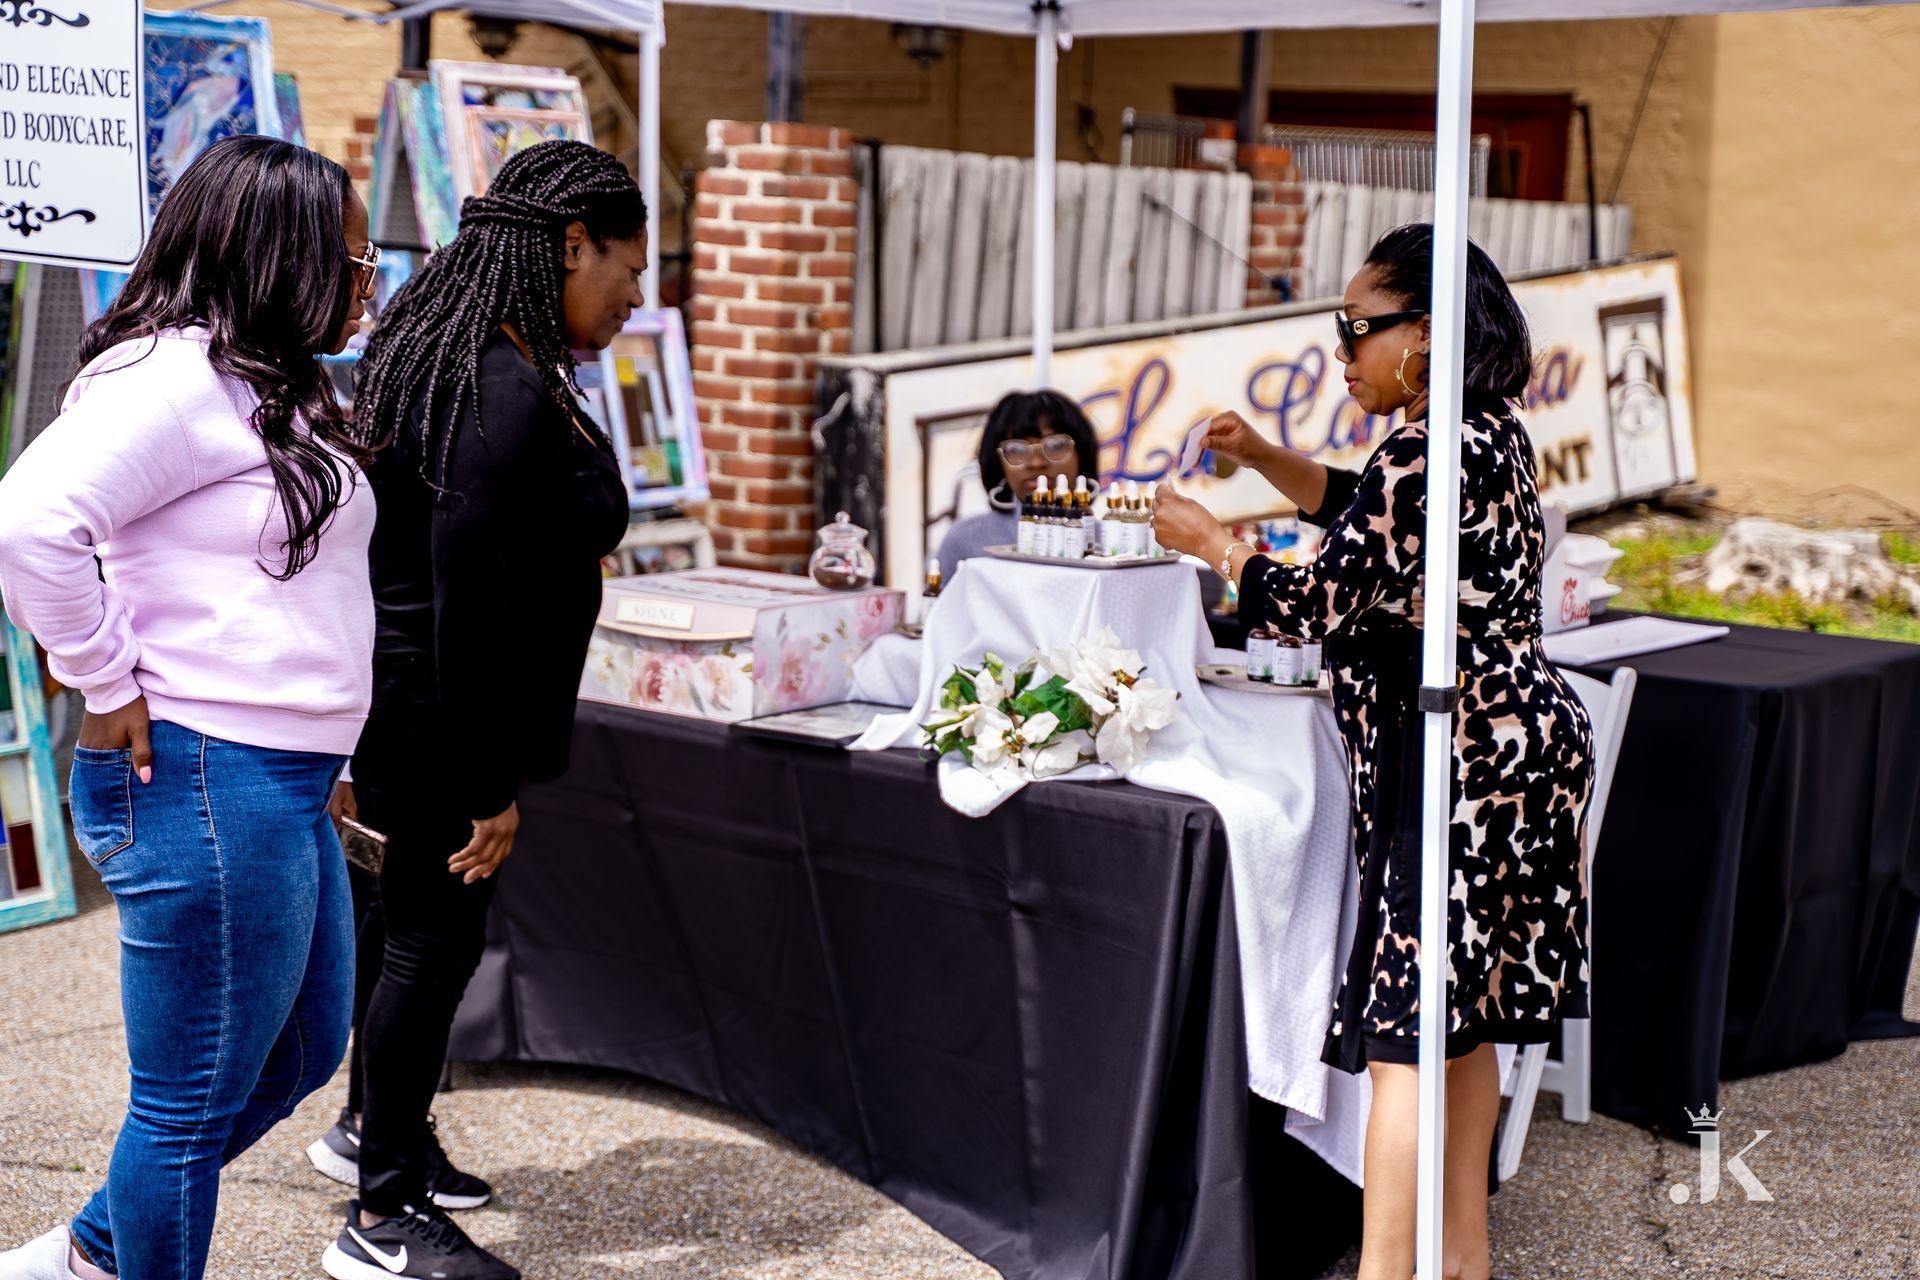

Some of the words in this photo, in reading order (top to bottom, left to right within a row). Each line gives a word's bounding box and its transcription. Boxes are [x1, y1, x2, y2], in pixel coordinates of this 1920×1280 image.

[27, 64, 131, 99] ELEGANCE
[24, 112, 133, 154] BODYCARE,
[5, 158, 41, 189] LLC
[632, 605, 678, 622] SHINE
